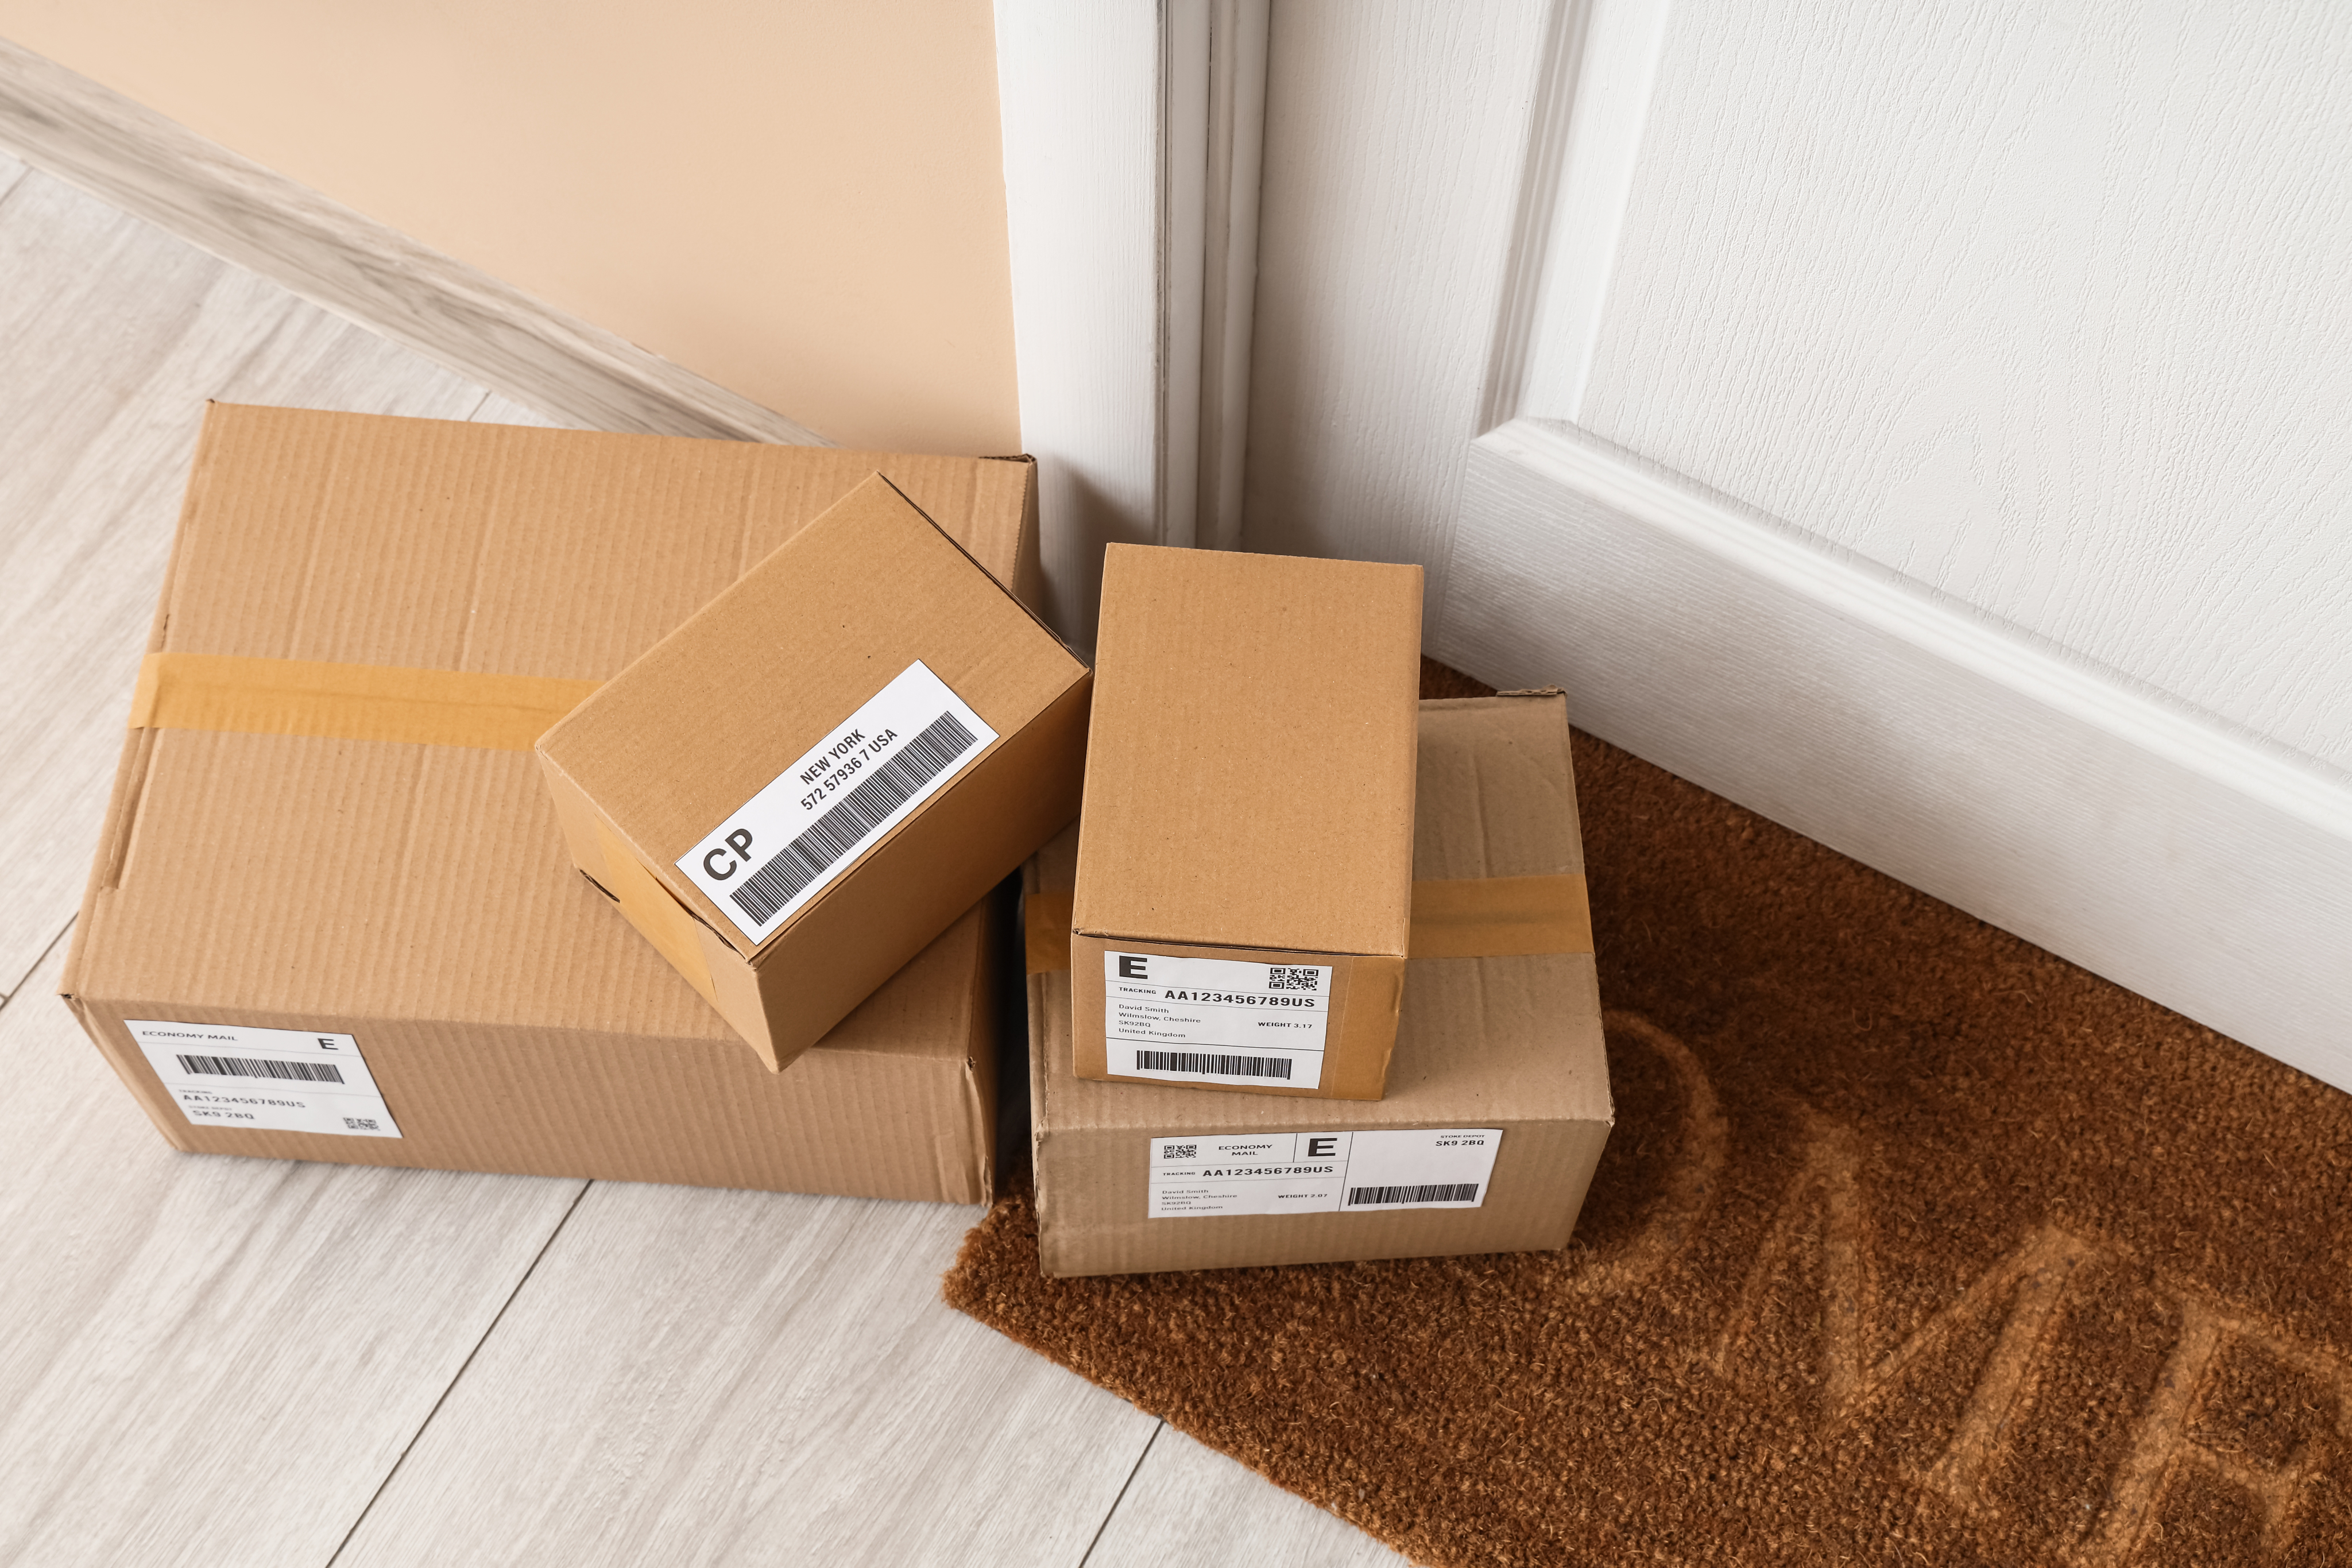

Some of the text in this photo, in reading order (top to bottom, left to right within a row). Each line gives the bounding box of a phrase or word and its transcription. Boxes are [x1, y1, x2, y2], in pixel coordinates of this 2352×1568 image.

[800, 729, 865, 785] NEW YORK
[800, 728, 898, 811] 572 57936 7 USA
[703, 828, 753, 881] CP
[1119, 955, 1148, 979] E
[1165, 990, 1315, 1008] AA123456789US
[1119, 1012, 1161, 1021] Wilmslow,
[142, 1031, 204, 1039] ECONOMY
[318, 1038, 339, 1050] E
[183, 1094, 306, 1108] AA123456789US
[1307, 1137, 1338, 1157] E
[1202, 1166, 1333, 1176] AA123456789US
